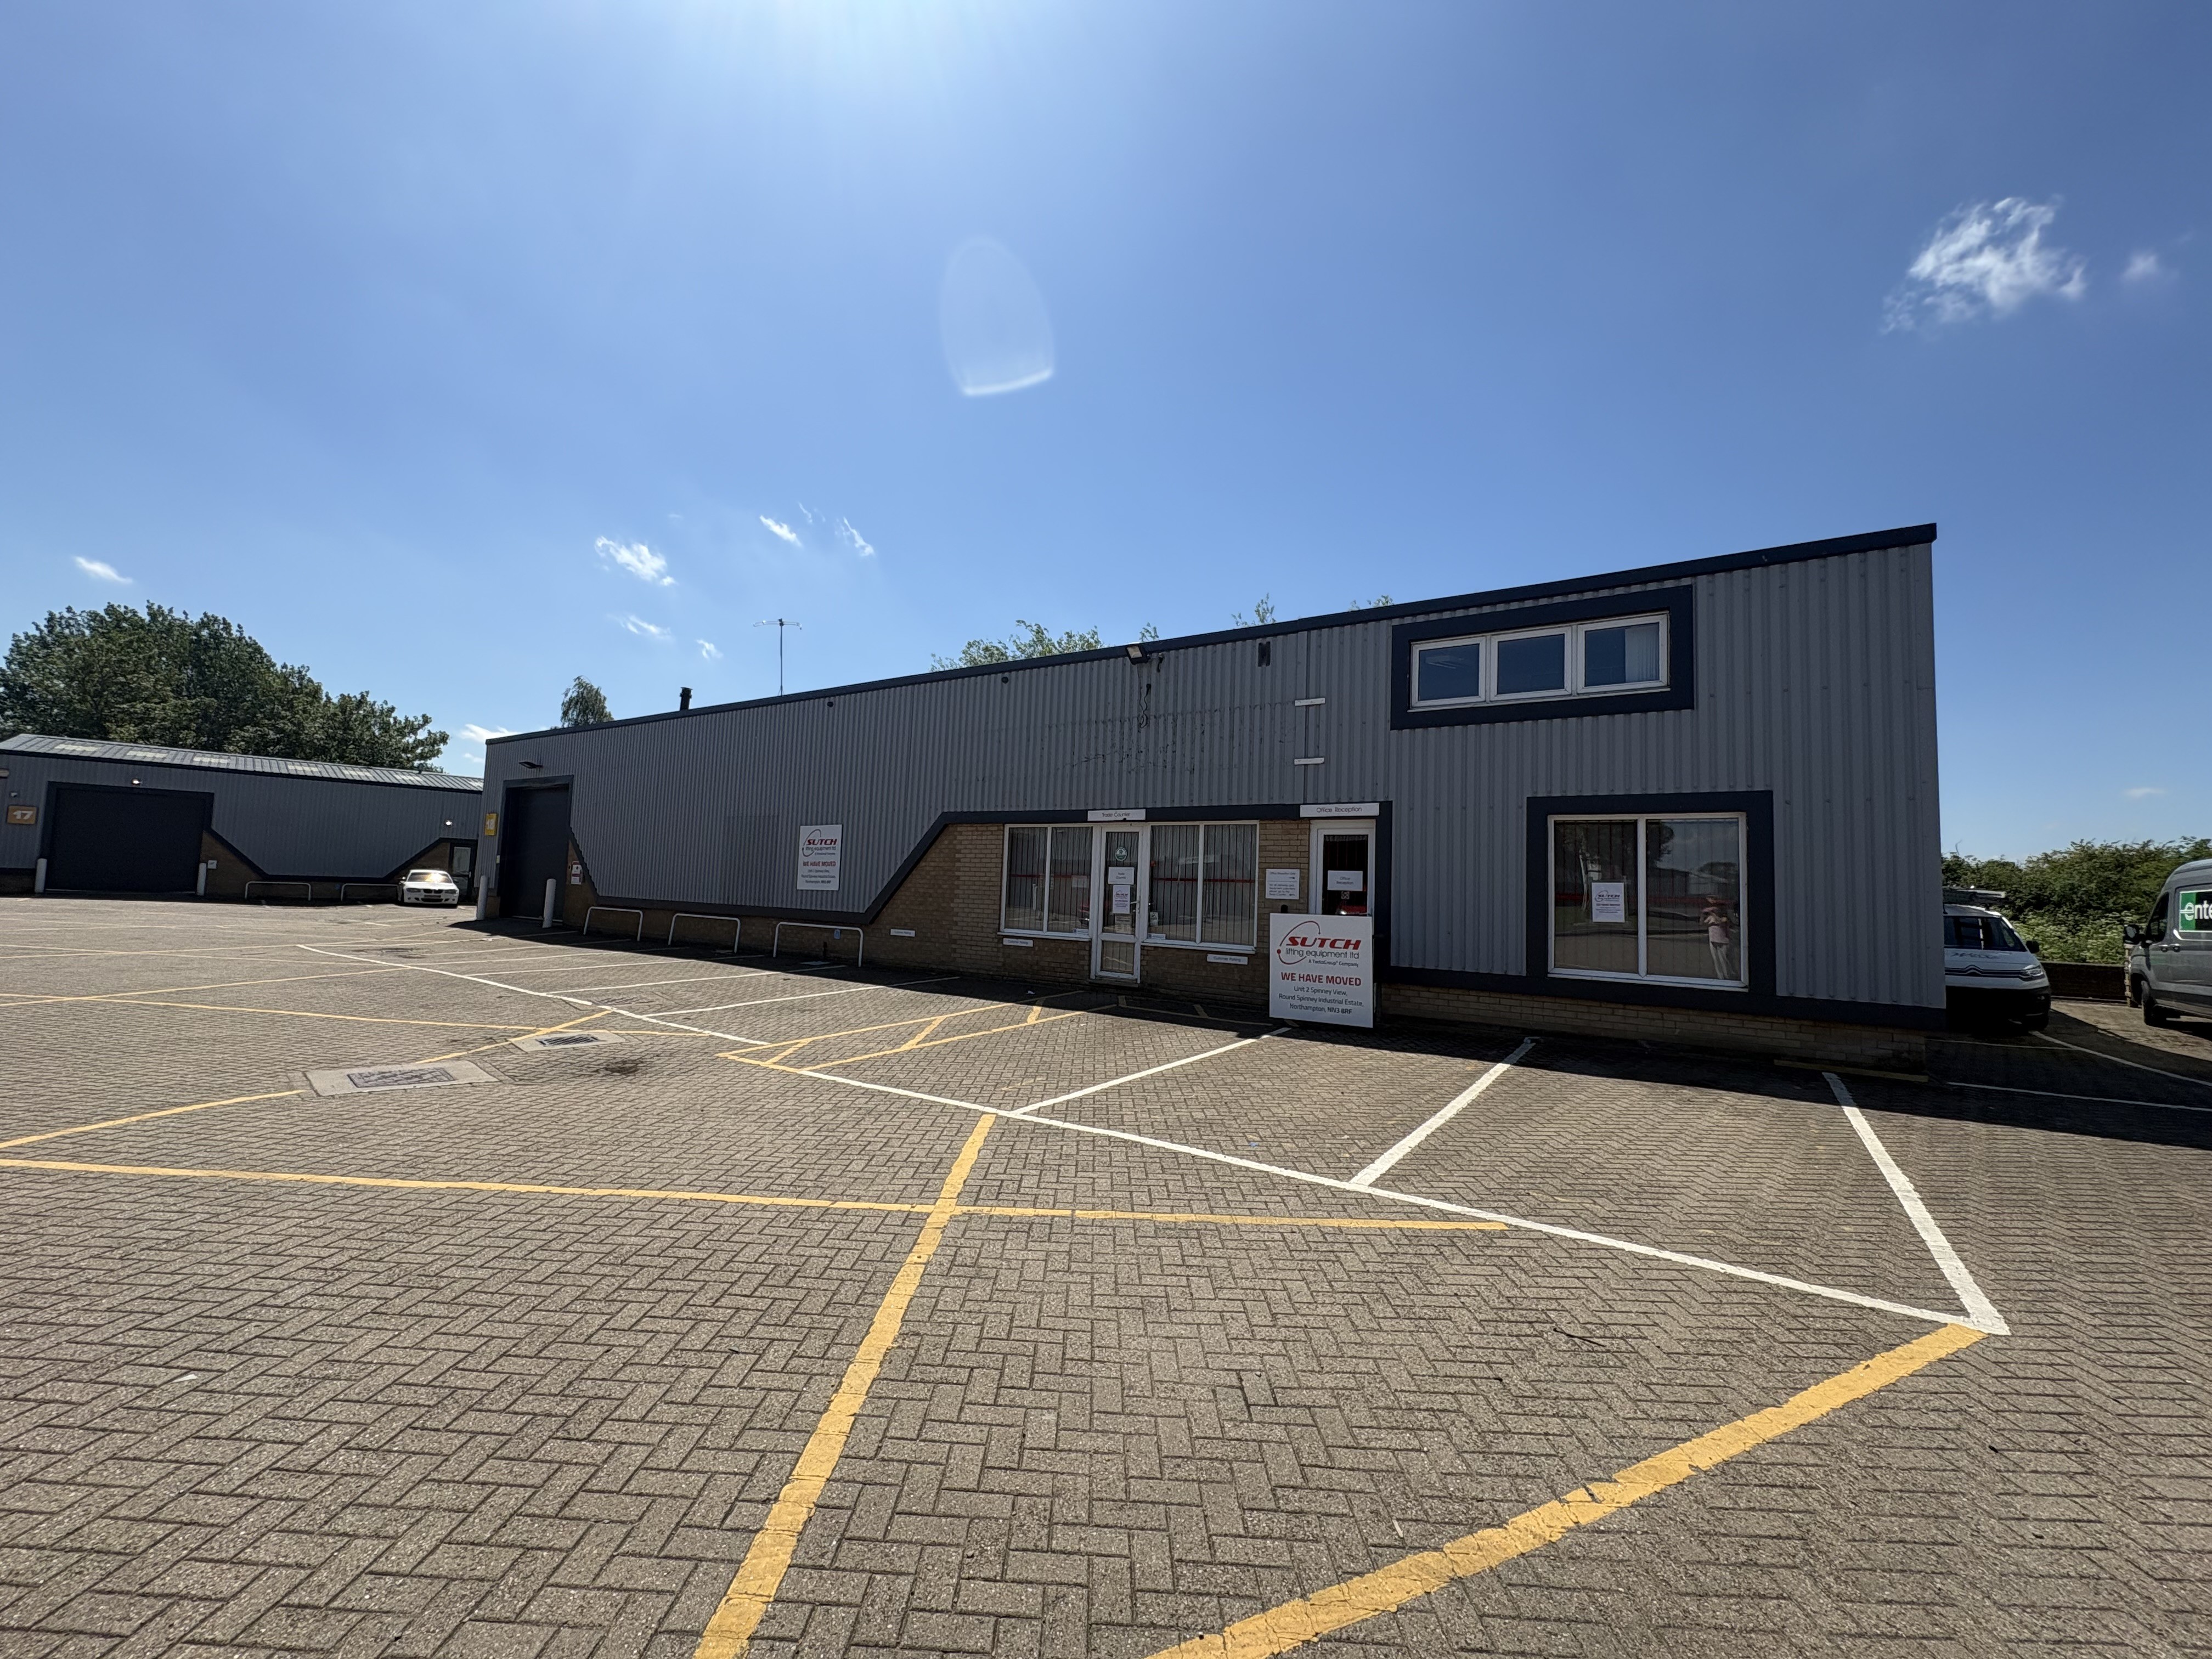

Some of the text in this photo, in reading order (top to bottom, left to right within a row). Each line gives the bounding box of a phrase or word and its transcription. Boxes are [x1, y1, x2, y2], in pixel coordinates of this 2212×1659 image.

[13, 810, 33, 820] 17
[1286, 936, 1362, 951] SUTCH
[1285, 948, 1359, 959] lifting equipment ltd
[1280, 972, 1362, 986] WE HAVE MOVED
[1311, 987, 1332, 996] Spinney
[1296, 995, 1317, 1003] Spinney
[1318, 996, 1344, 1005] Industrial
[1345, 999, 1364, 1007] Estate,
[1289, 1003, 1327, 1013] Northampton,
